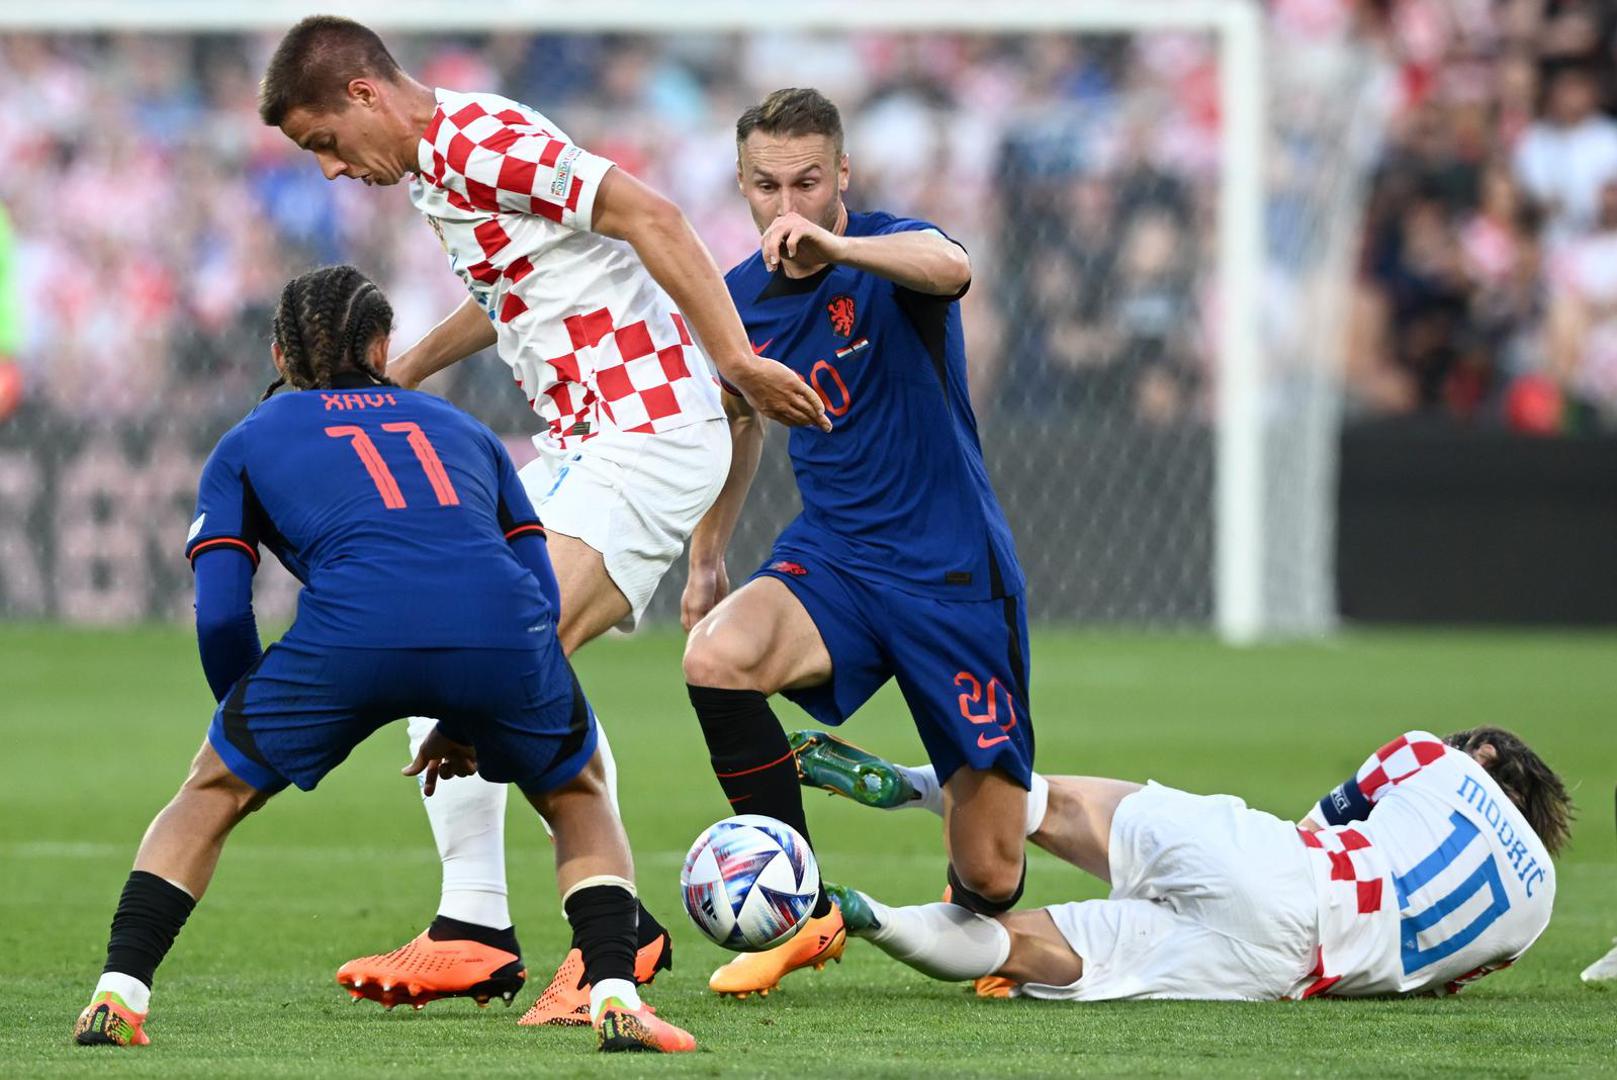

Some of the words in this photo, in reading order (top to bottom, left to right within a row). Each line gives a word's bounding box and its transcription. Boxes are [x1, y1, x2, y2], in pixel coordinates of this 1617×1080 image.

[320, 394, 397, 410] XAVI
[954, 671, 1017, 732] 20
[1391, 809, 1511, 976] 10
